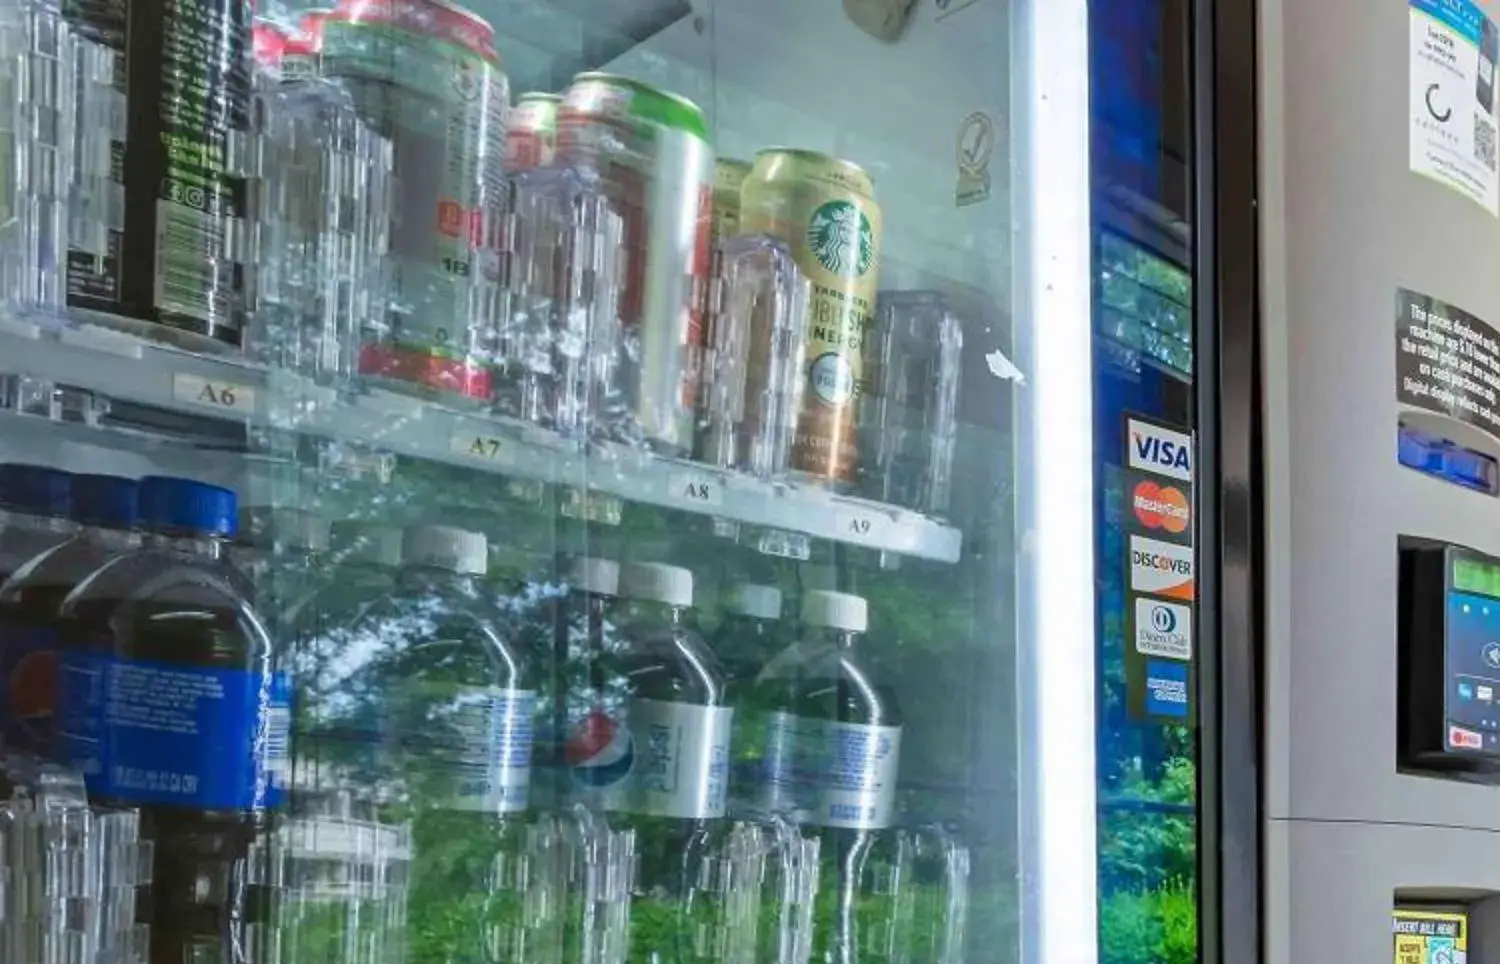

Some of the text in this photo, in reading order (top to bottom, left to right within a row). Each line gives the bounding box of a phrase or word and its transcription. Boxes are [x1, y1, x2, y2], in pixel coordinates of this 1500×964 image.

[198, 384, 235, 406] A6
[471, 437, 501, 456] A7
[1134, 433, 1190, 471] VISA
[683, 481, 710, 499] A8
[849, 518, 871, 535] A9
[1133, 551, 1191, 575] DISCOVER
